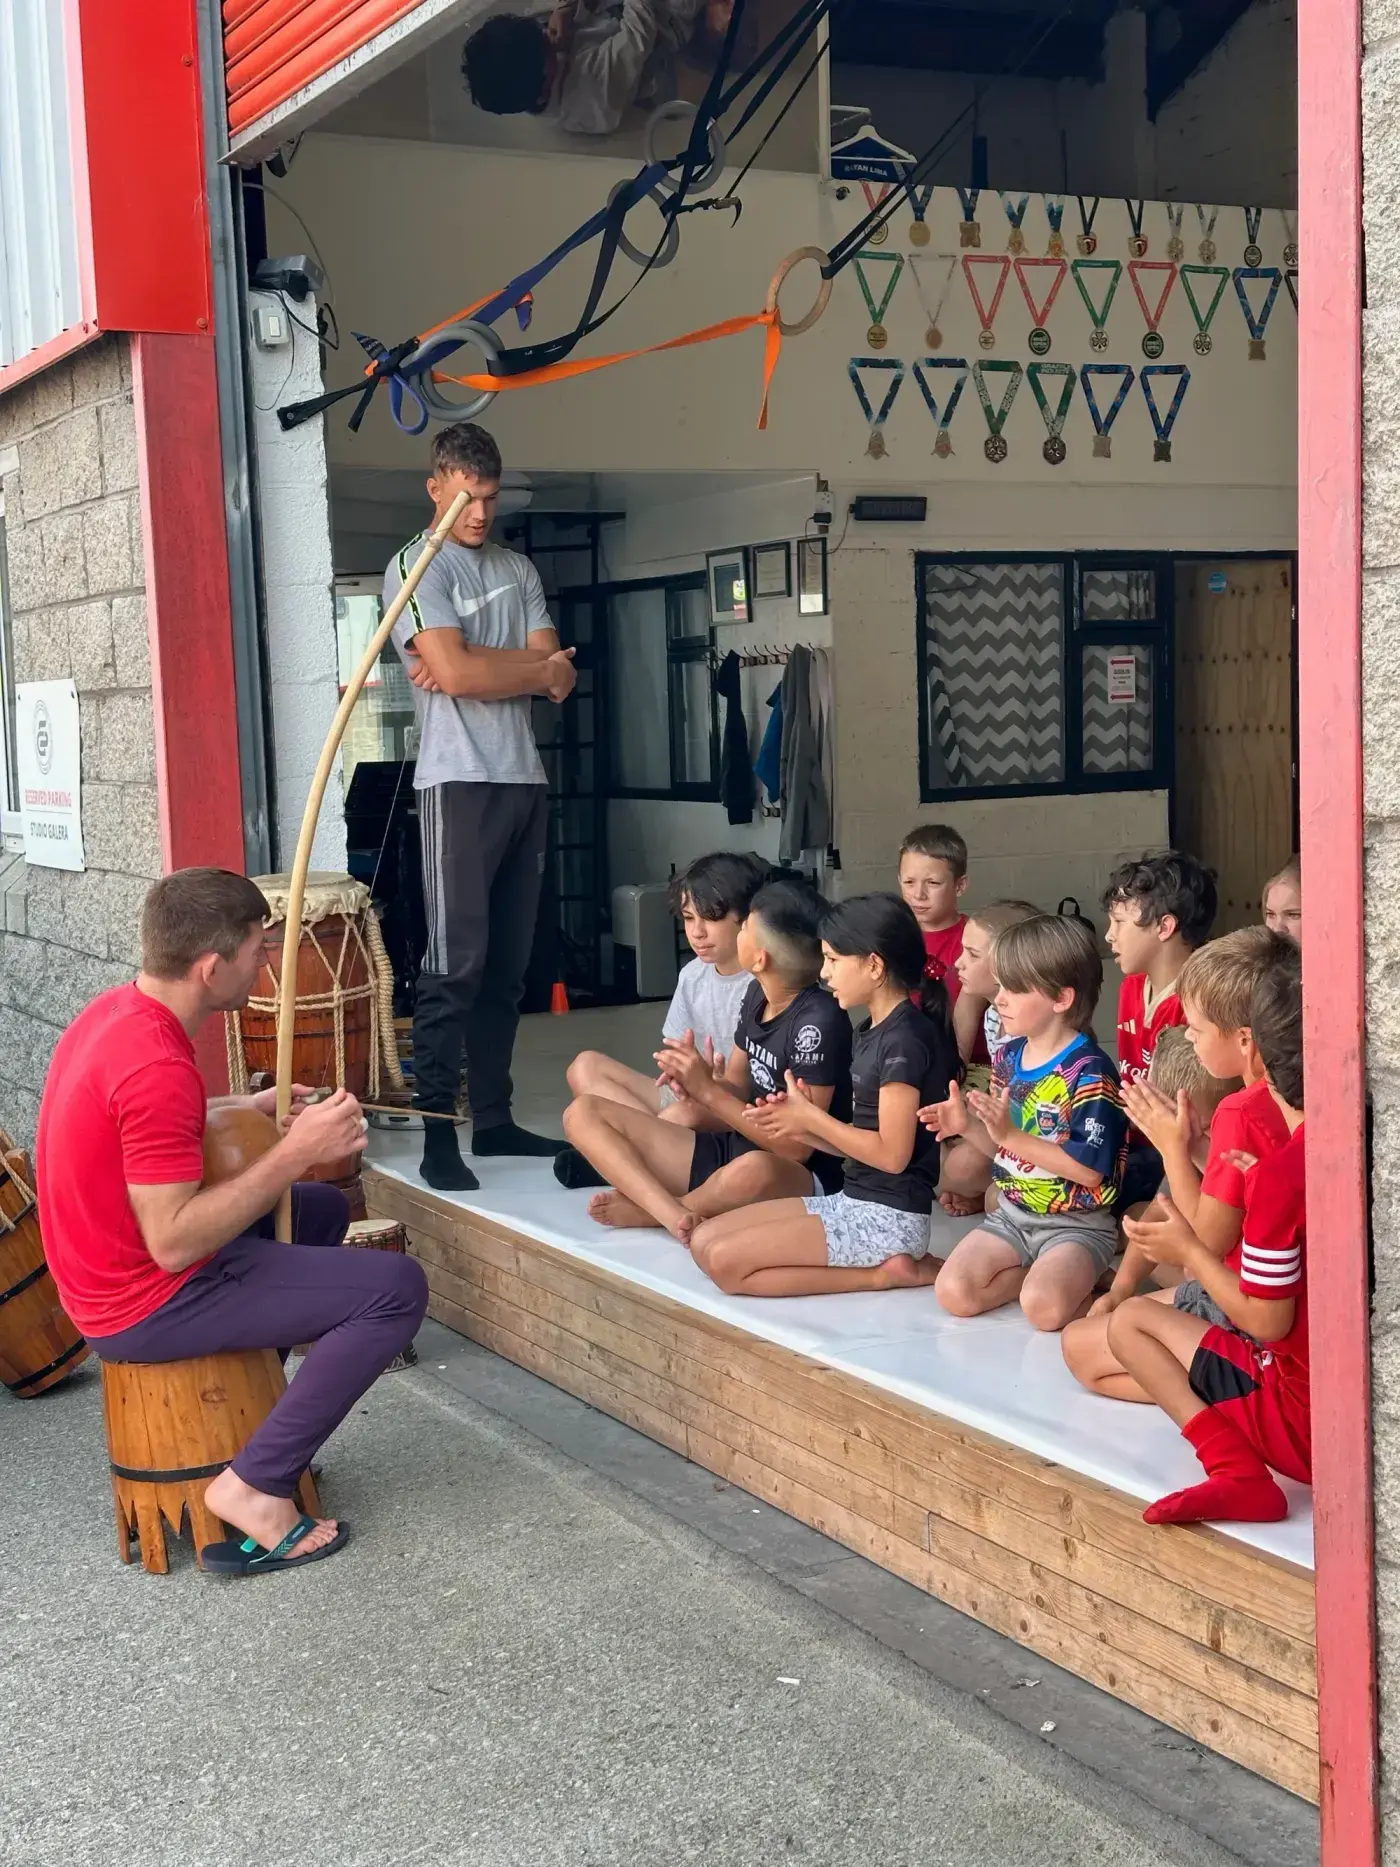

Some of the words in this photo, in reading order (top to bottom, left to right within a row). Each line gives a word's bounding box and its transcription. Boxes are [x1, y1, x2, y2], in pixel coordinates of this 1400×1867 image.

[25, 789, 46, 805] RESERVED
[48, 791, 71, 807] PARKING
[30, 822, 47, 837] STUDIO
[48, 824, 68, 840] GALERA
